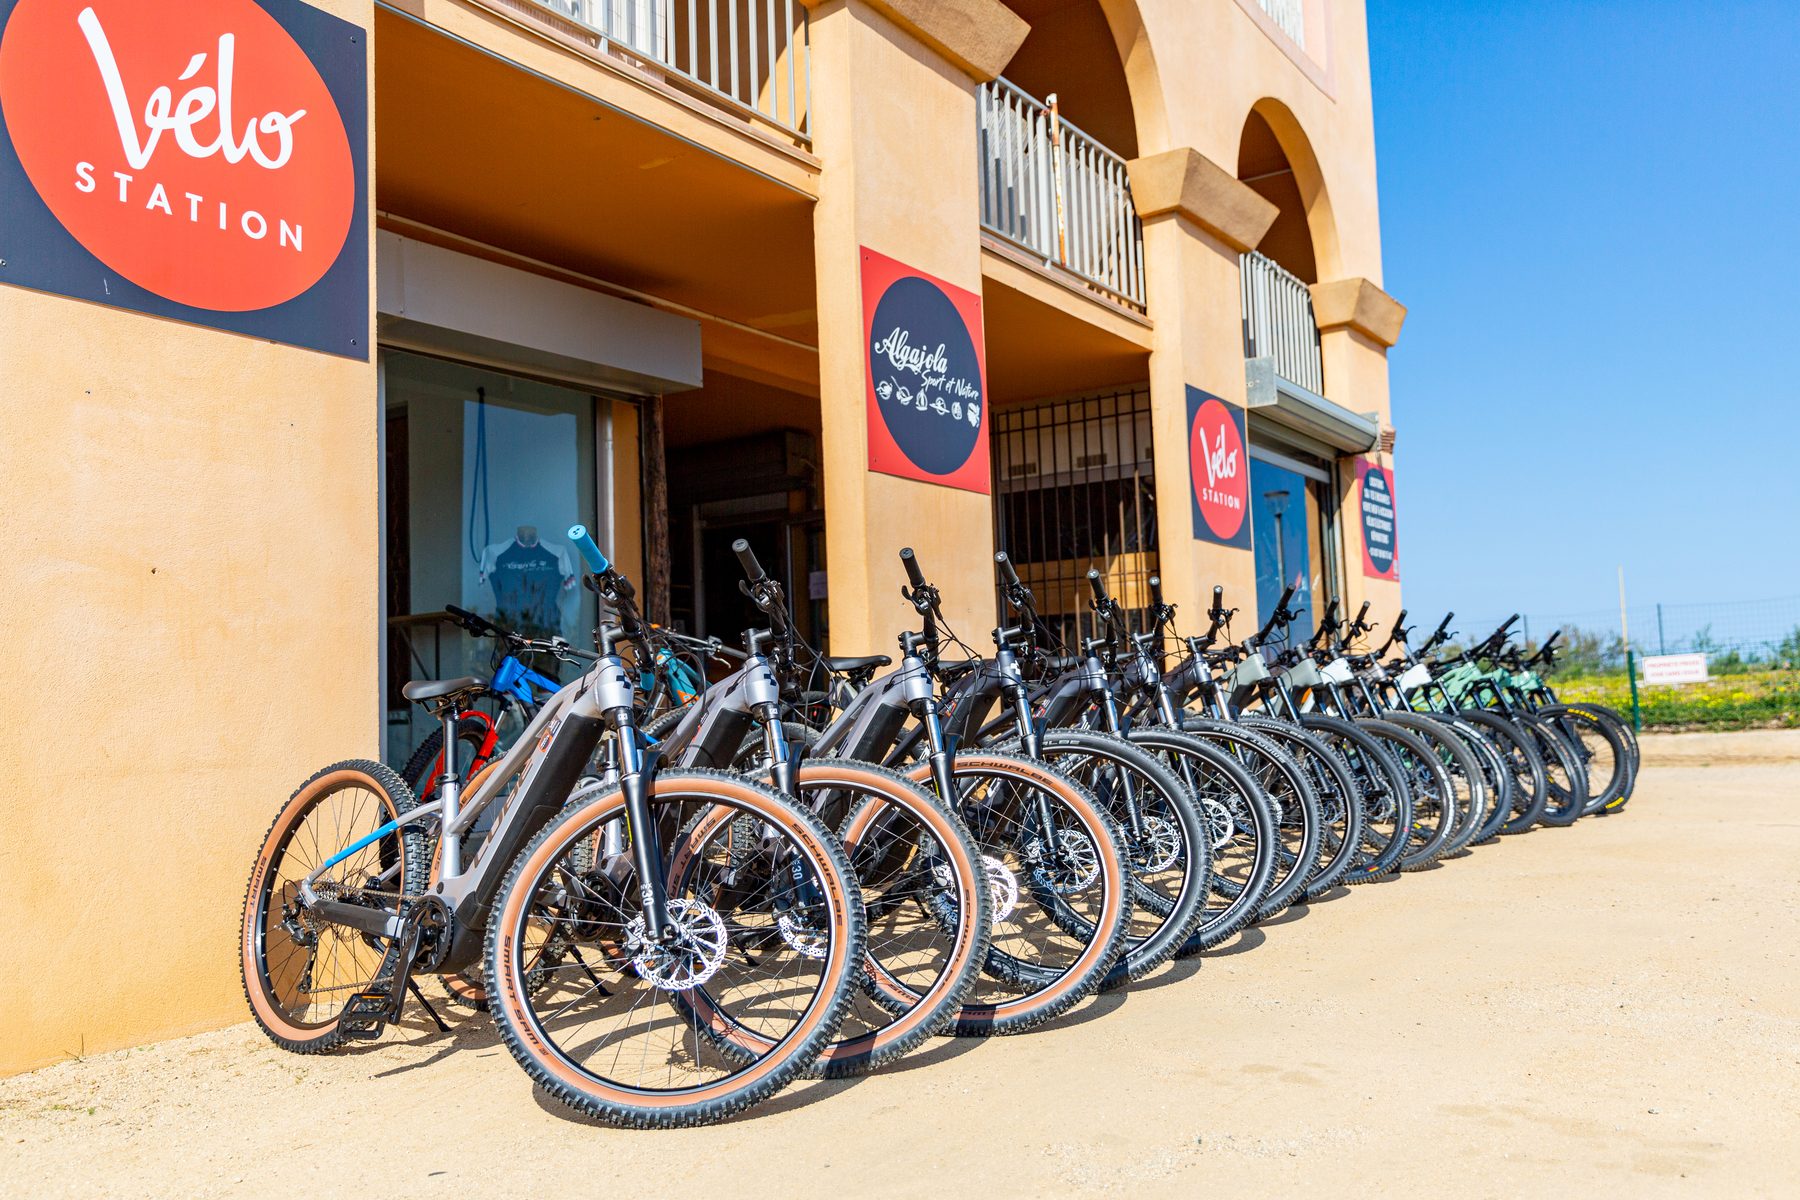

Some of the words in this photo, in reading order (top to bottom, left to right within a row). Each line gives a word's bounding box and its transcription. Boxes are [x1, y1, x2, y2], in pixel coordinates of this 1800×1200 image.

[78, 7, 307, 170] Vélo
[75, 161, 303, 252] STATION
[875, 327, 948, 375] Algajola
[921, 369, 946, 392] Sport
[945, 378, 956, 394] et
[955, 378, 979, 400] Nature
[1200, 424, 1238, 488] Vélo
[1203, 487, 1240, 509] STATION
[957, 761, 1054, 785] SCHWALBE
[250, 856, 267, 907] SMART
[641, 889, 655, 906] 30
[792, 823, 843, 927] SCHWALBE
[938, 889, 970, 994] SCHWALBE
[503, 935, 517, 1002] SMART
[514, 1008, 539, 1045] SAM
